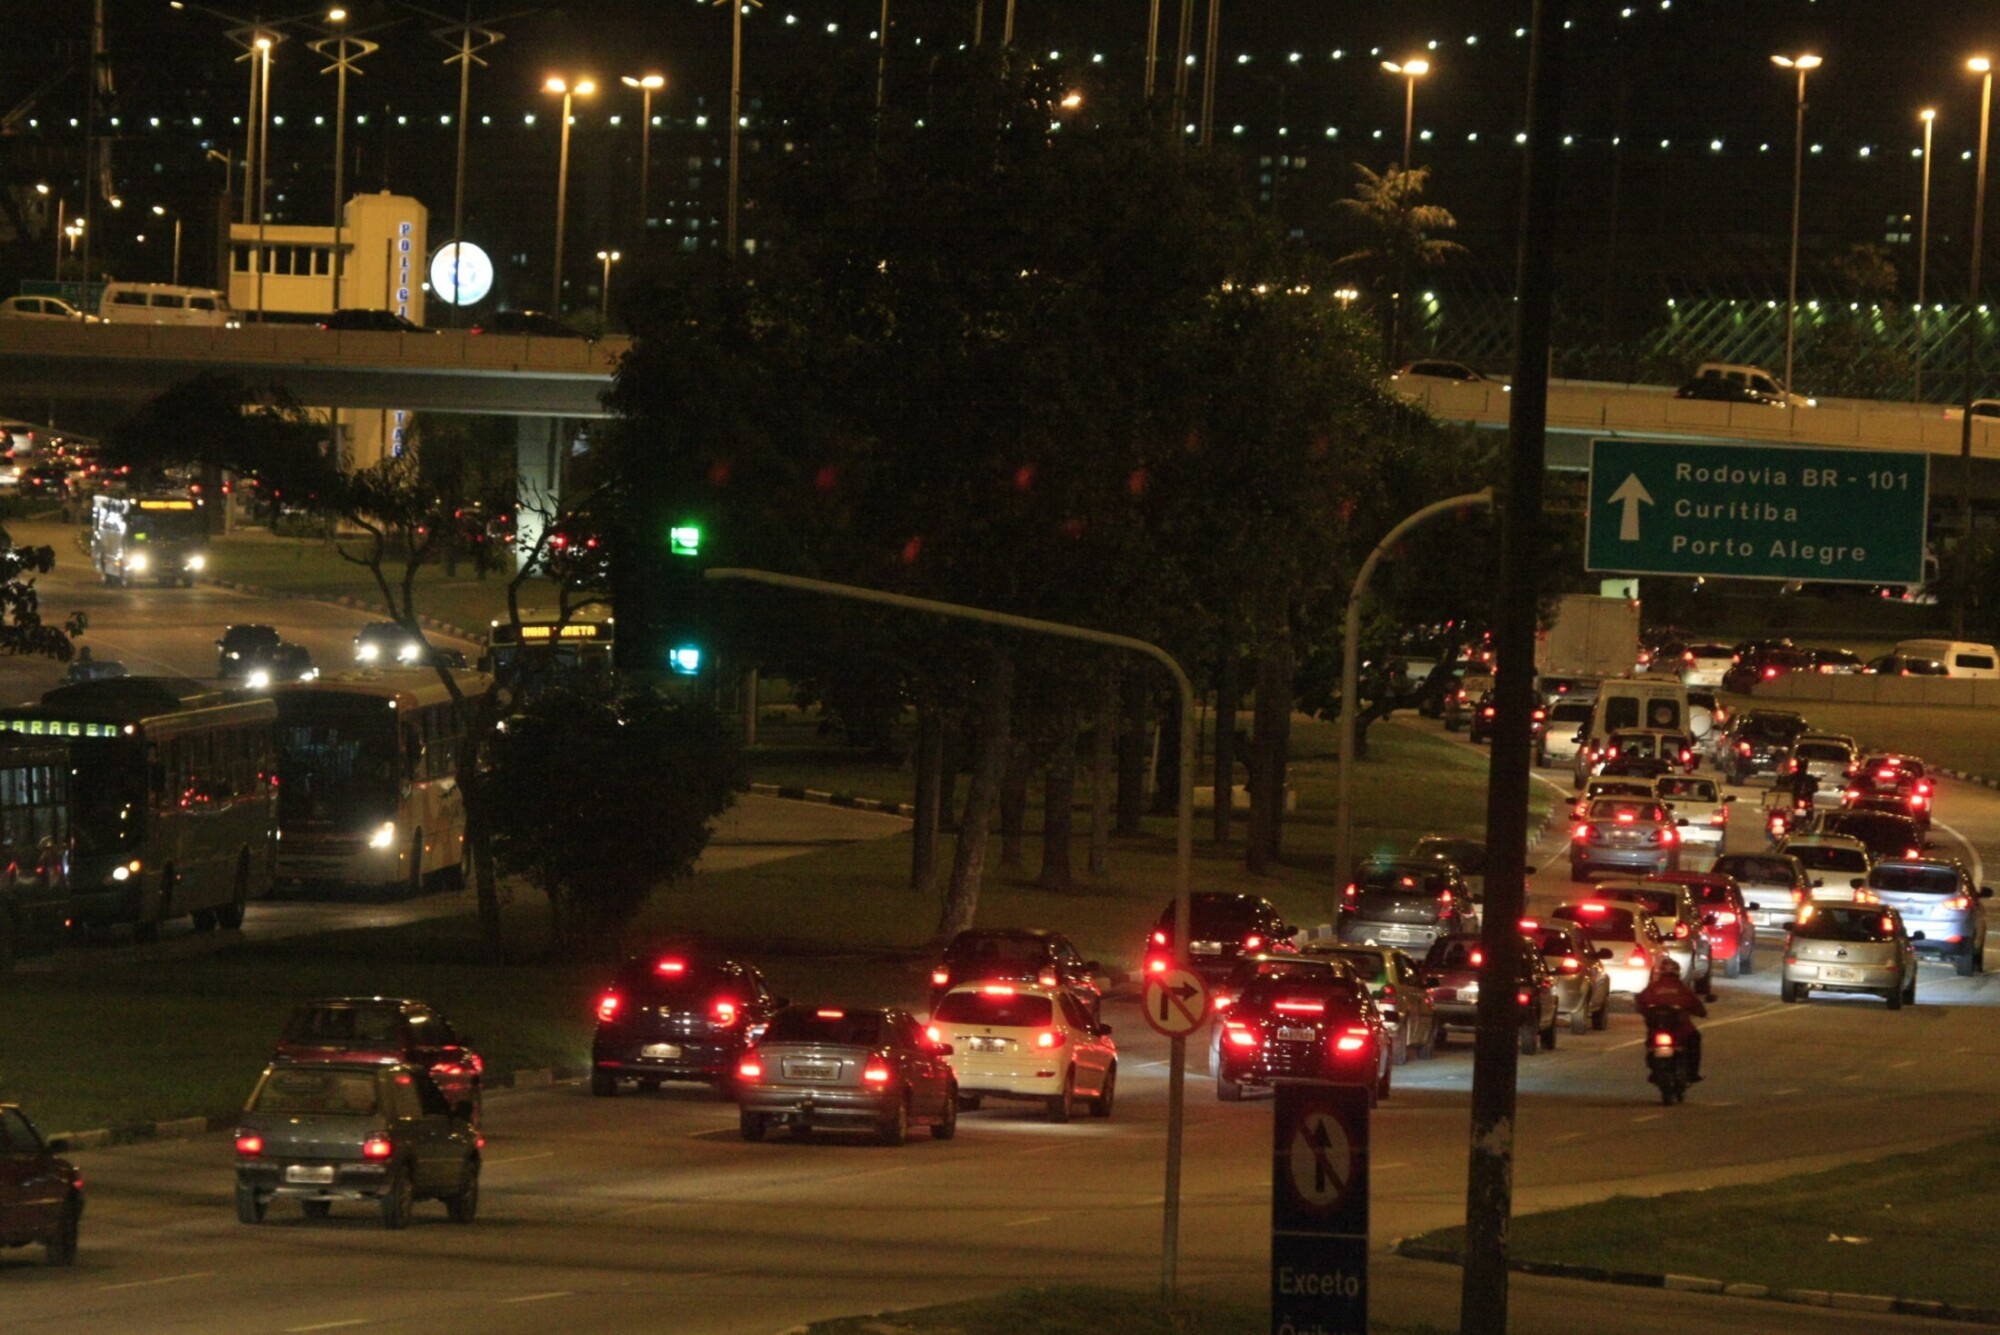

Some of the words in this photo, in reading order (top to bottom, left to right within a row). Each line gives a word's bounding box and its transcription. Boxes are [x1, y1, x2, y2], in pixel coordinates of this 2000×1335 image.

[1675, 463, 1787, 487] Rodovia
[1802, 469, 1838, 488] BR
[1867, 471, 1909, 490] 101
[1674, 499, 1798, 522] Curitiba
[1671, 535, 1753, 557] Porto
[1769, 540, 1866, 566] Alegre
[1278, 1266, 1360, 1297] Exceto
